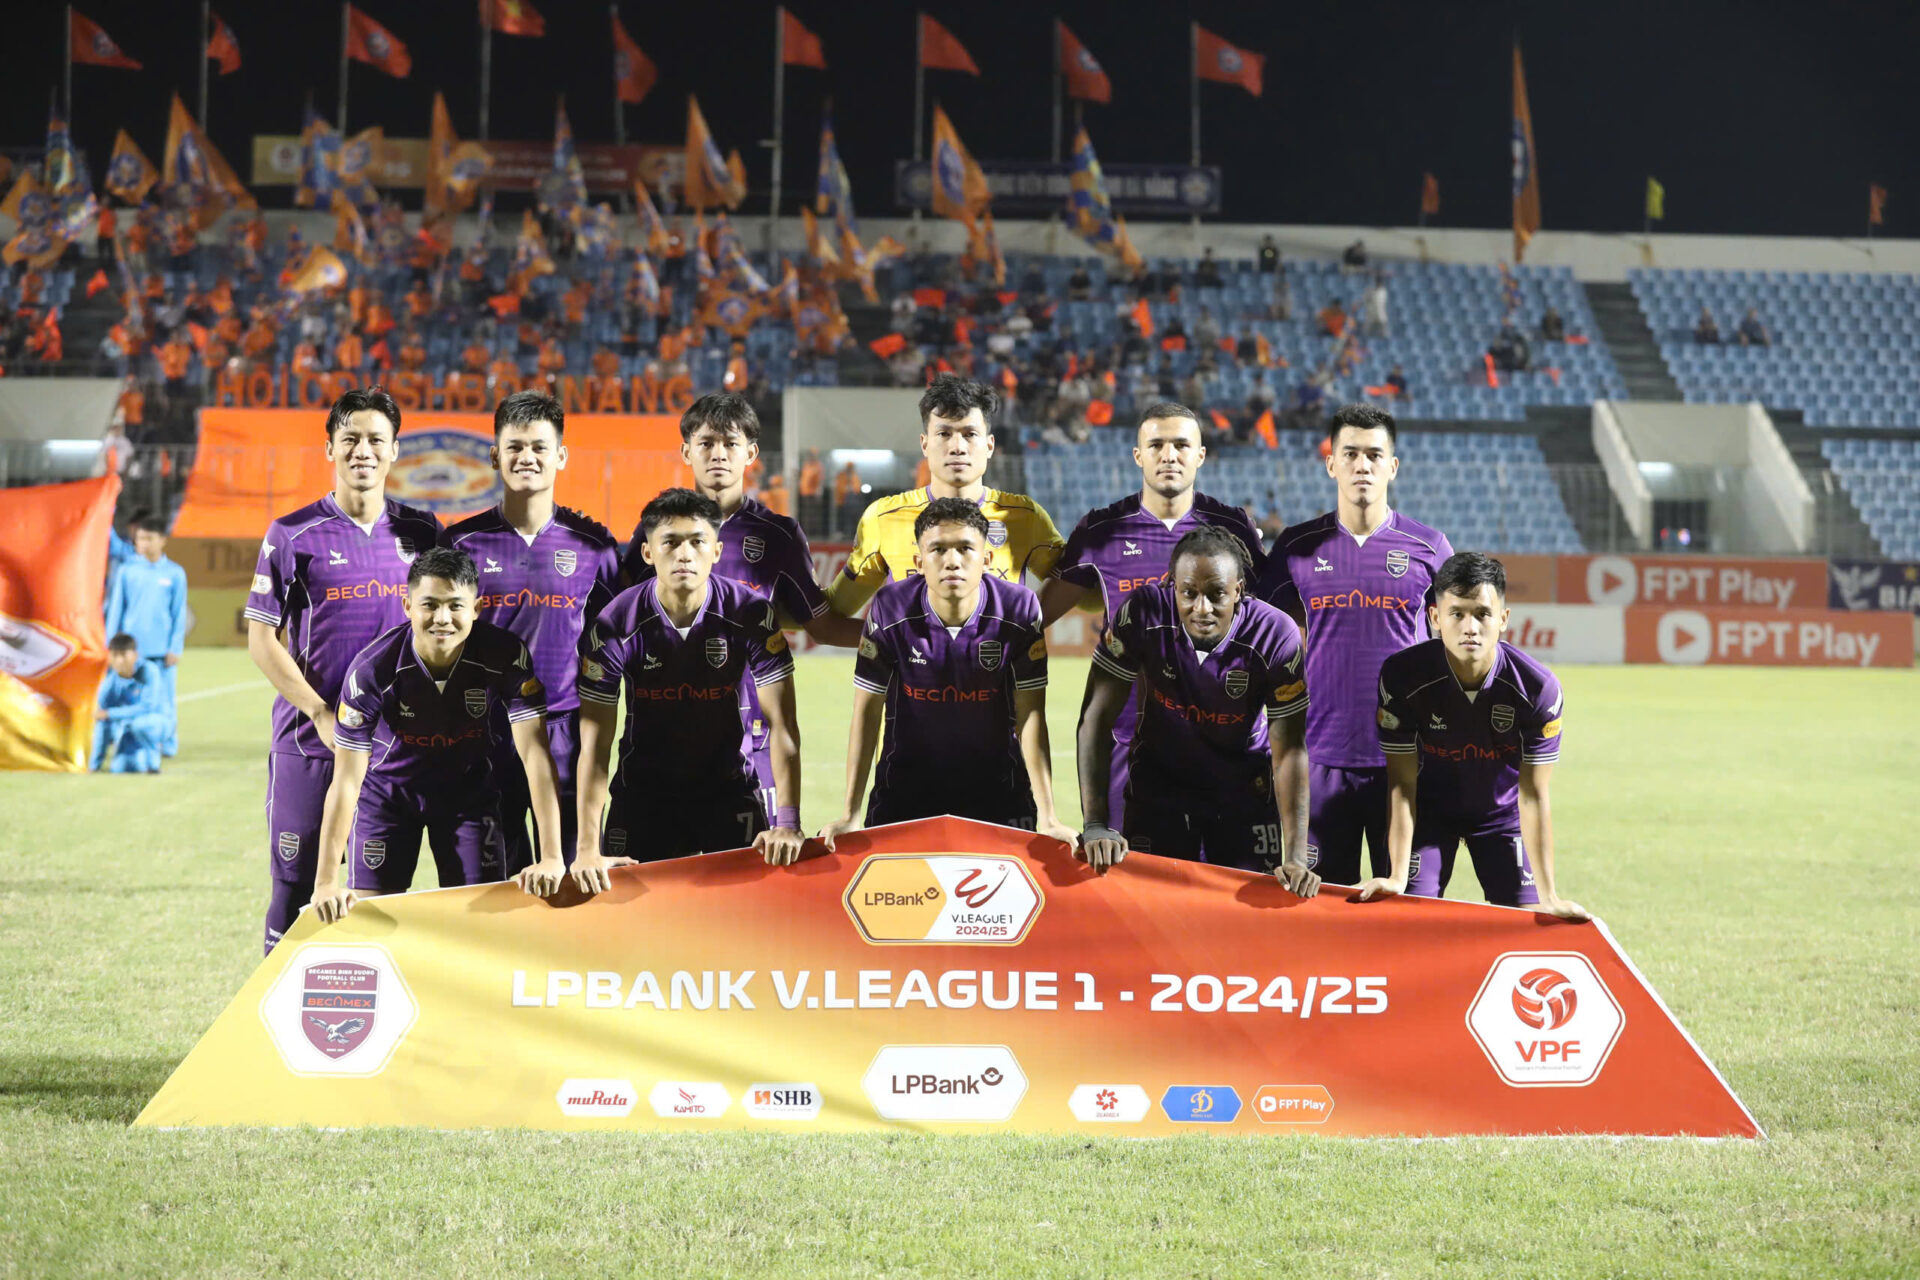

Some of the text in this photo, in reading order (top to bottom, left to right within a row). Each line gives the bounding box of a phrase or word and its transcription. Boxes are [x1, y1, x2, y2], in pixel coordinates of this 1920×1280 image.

[326, 578, 409, 601] BECAME
[480, 588, 577, 608] BECAMEX
[1643, 567, 1796, 610] FPT Play
[1310, 589, 1410, 610] BECAMEX
[1717, 620, 1880, 666] FPT Play
[903, 684, 999, 703] BECAME
[481, 816, 497, 846] 2
[736, 811, 753, 842] 7
[1252, 823, 1280, 854] 39
[864, 892, 924, 907] LPBank
[951, 914, 1014, 924] V.LEAGUE 1
[955, 925, 1008, 937] 2024/25
[307, 995, 372, 1008] BECAMEX
[512, 969, 757, 1011] LPBANK
[771, 969, 1059, 1010] V.LEAGUE
[1074, 972, 1104, 1011] 1
[1150, 974, 1389, 1019] 2024/25
[1514, 1040, 1581, 1062] VPF
[891, 1074, 981, 1095] LPBank
[566, 1090, 628, 1106] muRata
[772, 1090, 812, 1106] SHB
[1278, 1098, 1326, 1111] FPT Play
[673, 1105, 706, 1113] KAMITO
